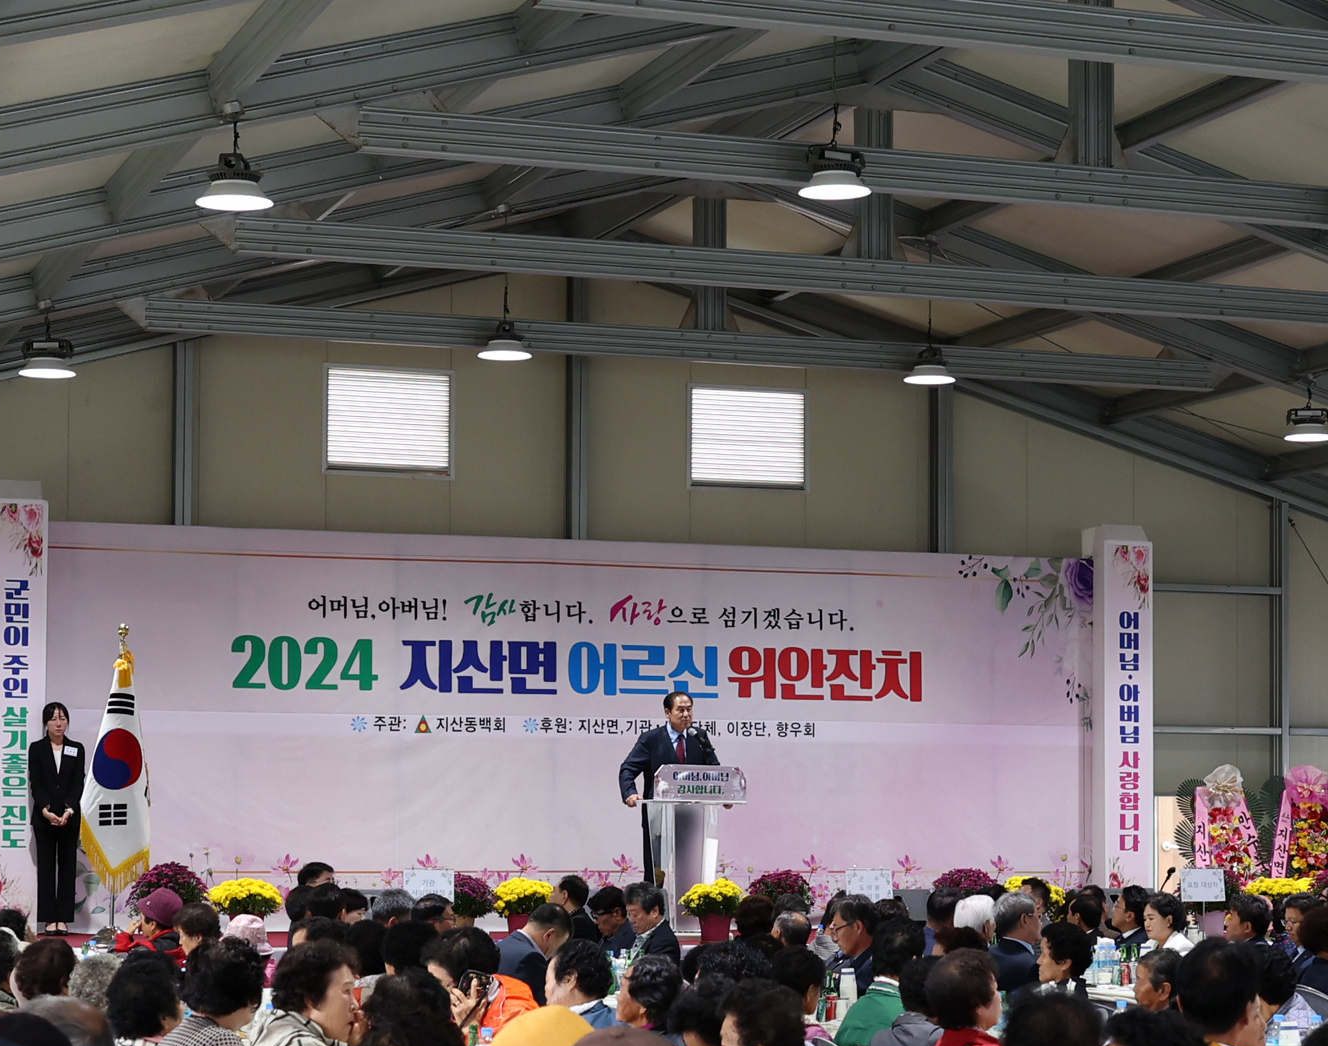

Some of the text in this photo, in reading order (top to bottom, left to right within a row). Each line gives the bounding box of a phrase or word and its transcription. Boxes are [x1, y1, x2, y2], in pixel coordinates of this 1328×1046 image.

[464, 592, 594, 627] 감사합니다.
[609, 594, 710, 626] 사랑으로
[718, 606, 855, 632] 섬기겠습니다.
[231, 634, 923, 702] 2024 지산면 어르신 위안잔치
[0, 579, 30, 849] 군민이 주인 살기좋은 진도
[373, 716, 507, 733] 주관: 지산동백회
[539, 717, 573, 734] 후원:
[726, 720, 771, 738] 이장단,
[775, 721, 816, 738] 향우회
[1118, 751, 1141, 852] 사랑합니다
